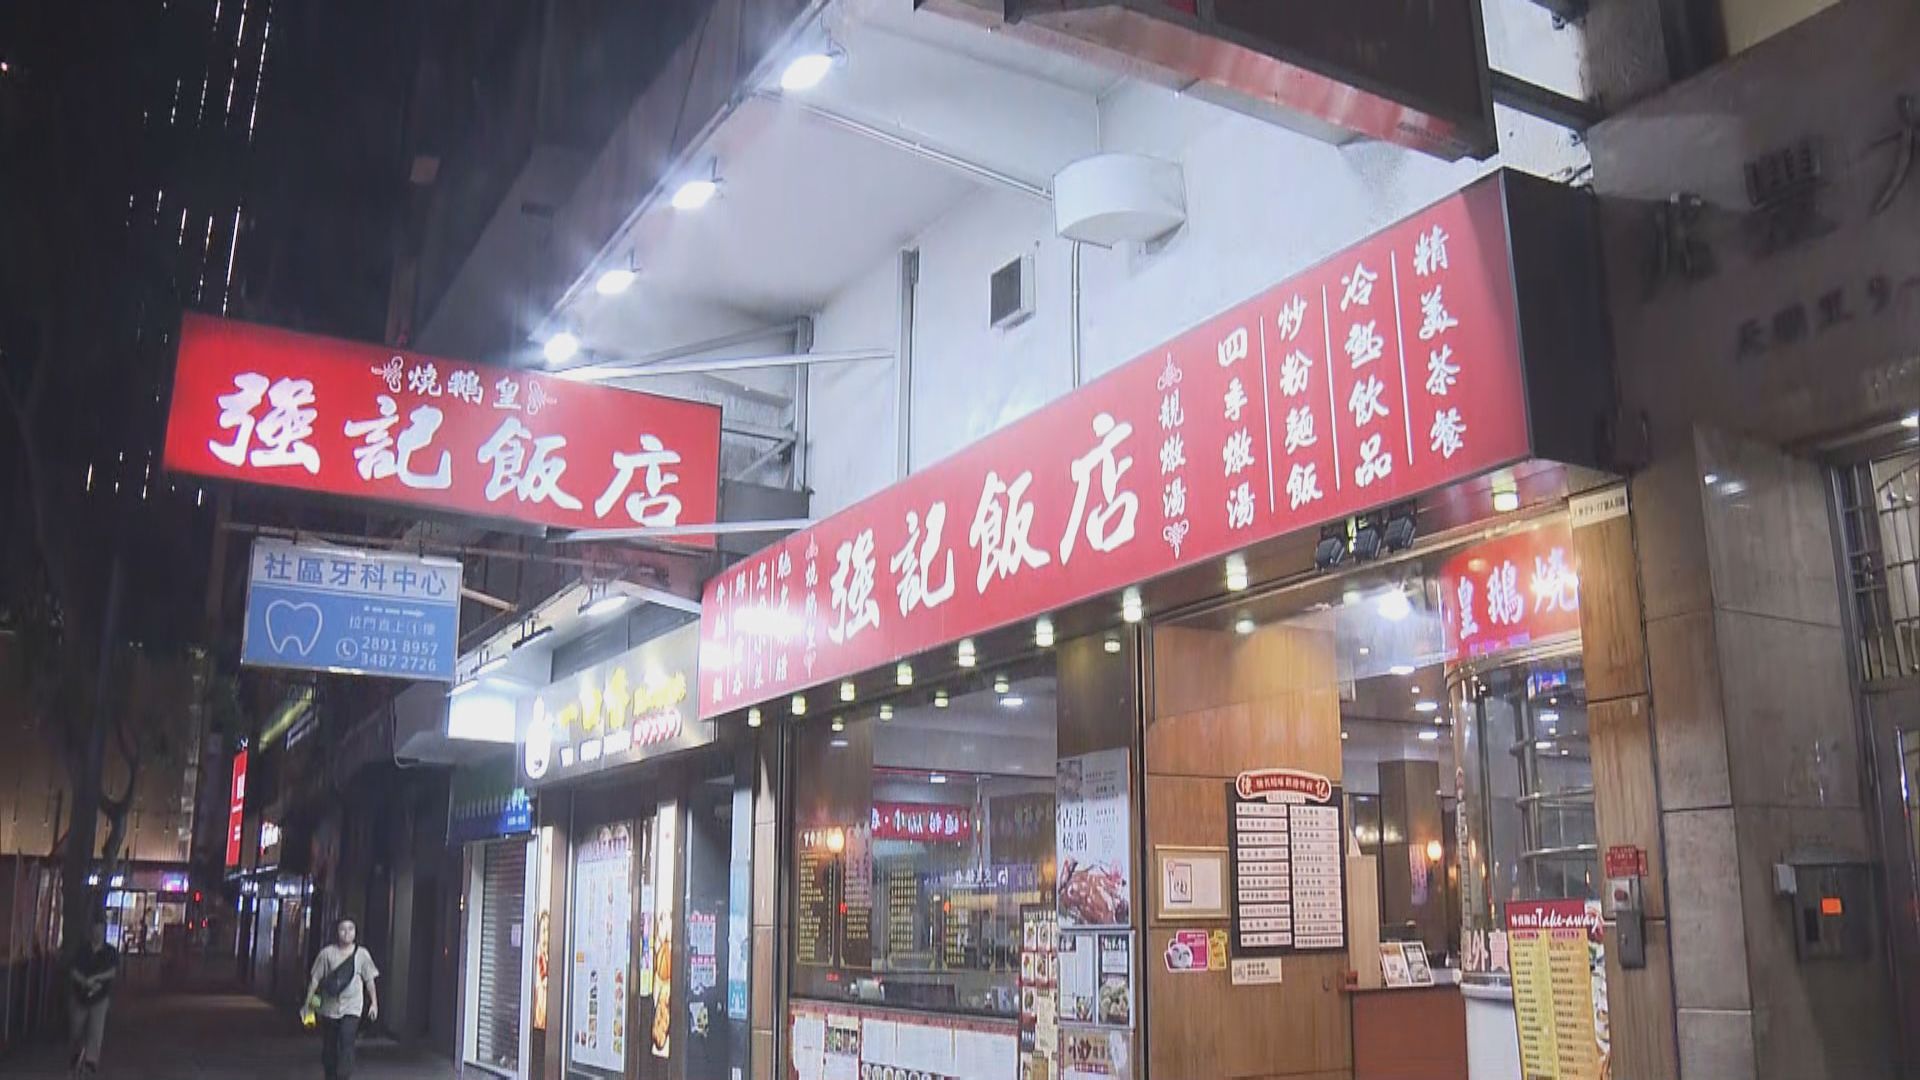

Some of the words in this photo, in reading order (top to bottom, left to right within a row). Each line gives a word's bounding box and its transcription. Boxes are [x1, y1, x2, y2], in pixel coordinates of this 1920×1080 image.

[1413, 224, 1467, 459] 精美茶餐
[1340, 262, 1392, 488] 冷熱飲品
[264, 551, 447, 597] 社區牙科中心
[361, 636, 397, 652] 2891
[402, 640, 439, 656] 8957
[401, 656, 437, 671] 2726
